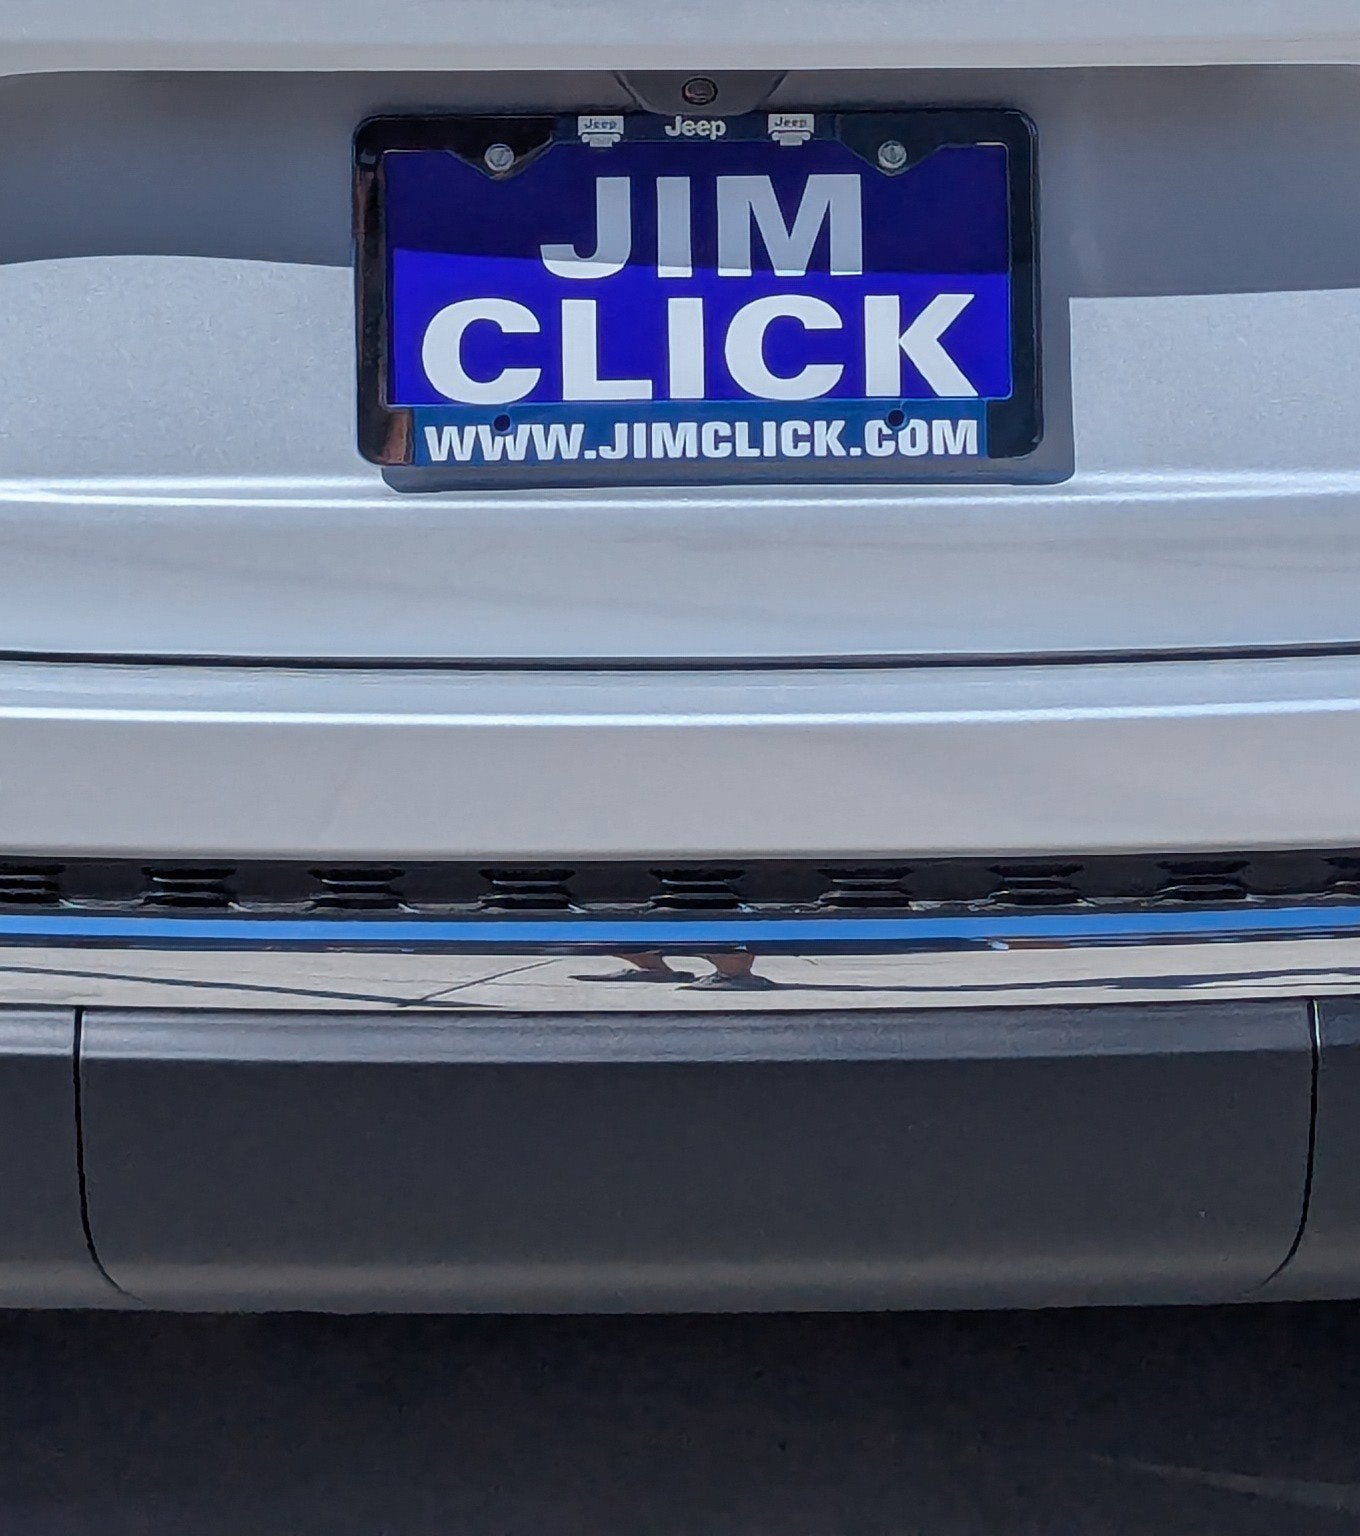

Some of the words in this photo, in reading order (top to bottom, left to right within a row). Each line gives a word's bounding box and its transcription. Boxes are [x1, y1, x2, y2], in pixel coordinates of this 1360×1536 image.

[583, 118, 619, 131] Jeep
[664, 115, 727, 141] Jeep
[773, 116, 808, 129] Jeep
[540, 173, 863, 280] JIM
[420, 293, 980, 405] CLICK
[424, 418, 980, 463] WWW.JIMCLICK.COM
